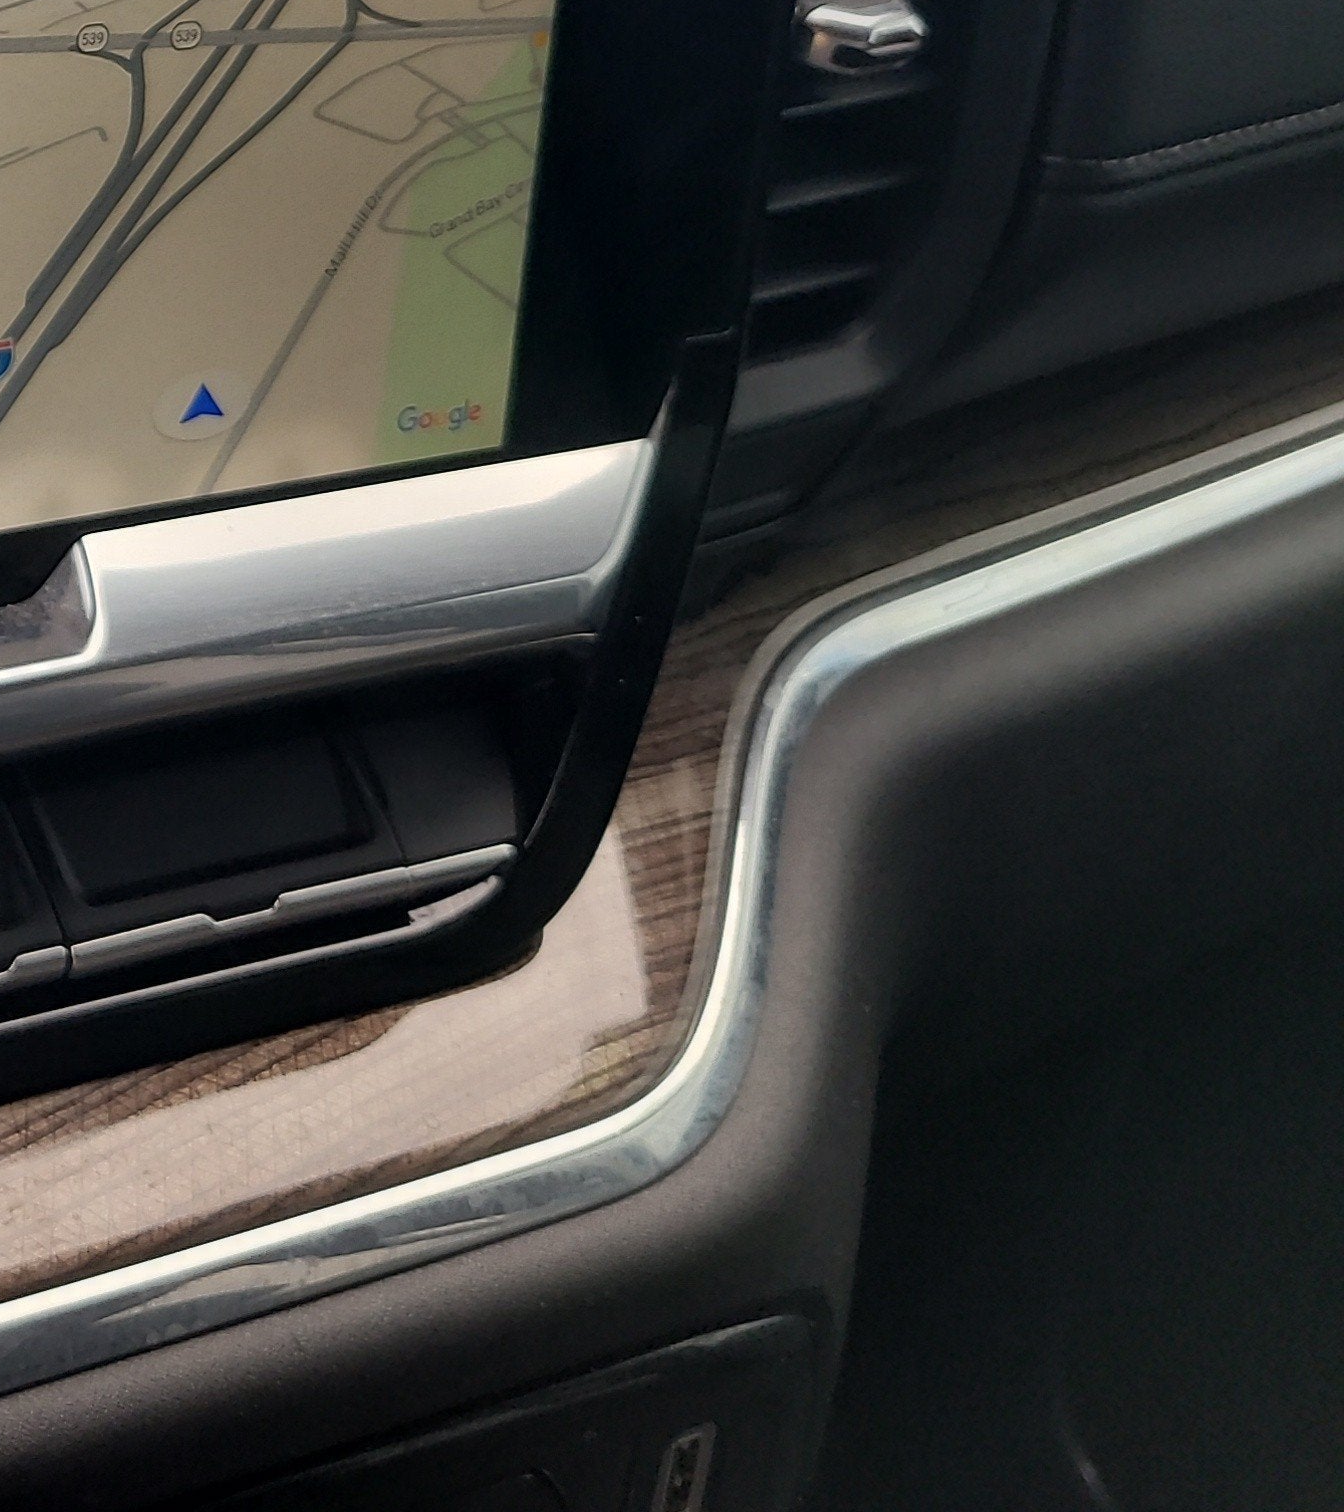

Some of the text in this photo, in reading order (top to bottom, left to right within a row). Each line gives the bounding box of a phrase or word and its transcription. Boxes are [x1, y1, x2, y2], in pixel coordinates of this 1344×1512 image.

[81, 29, 104, 48] 539
[175, 26, 199, 45] 539
[397, 399, 482, 431] Google
